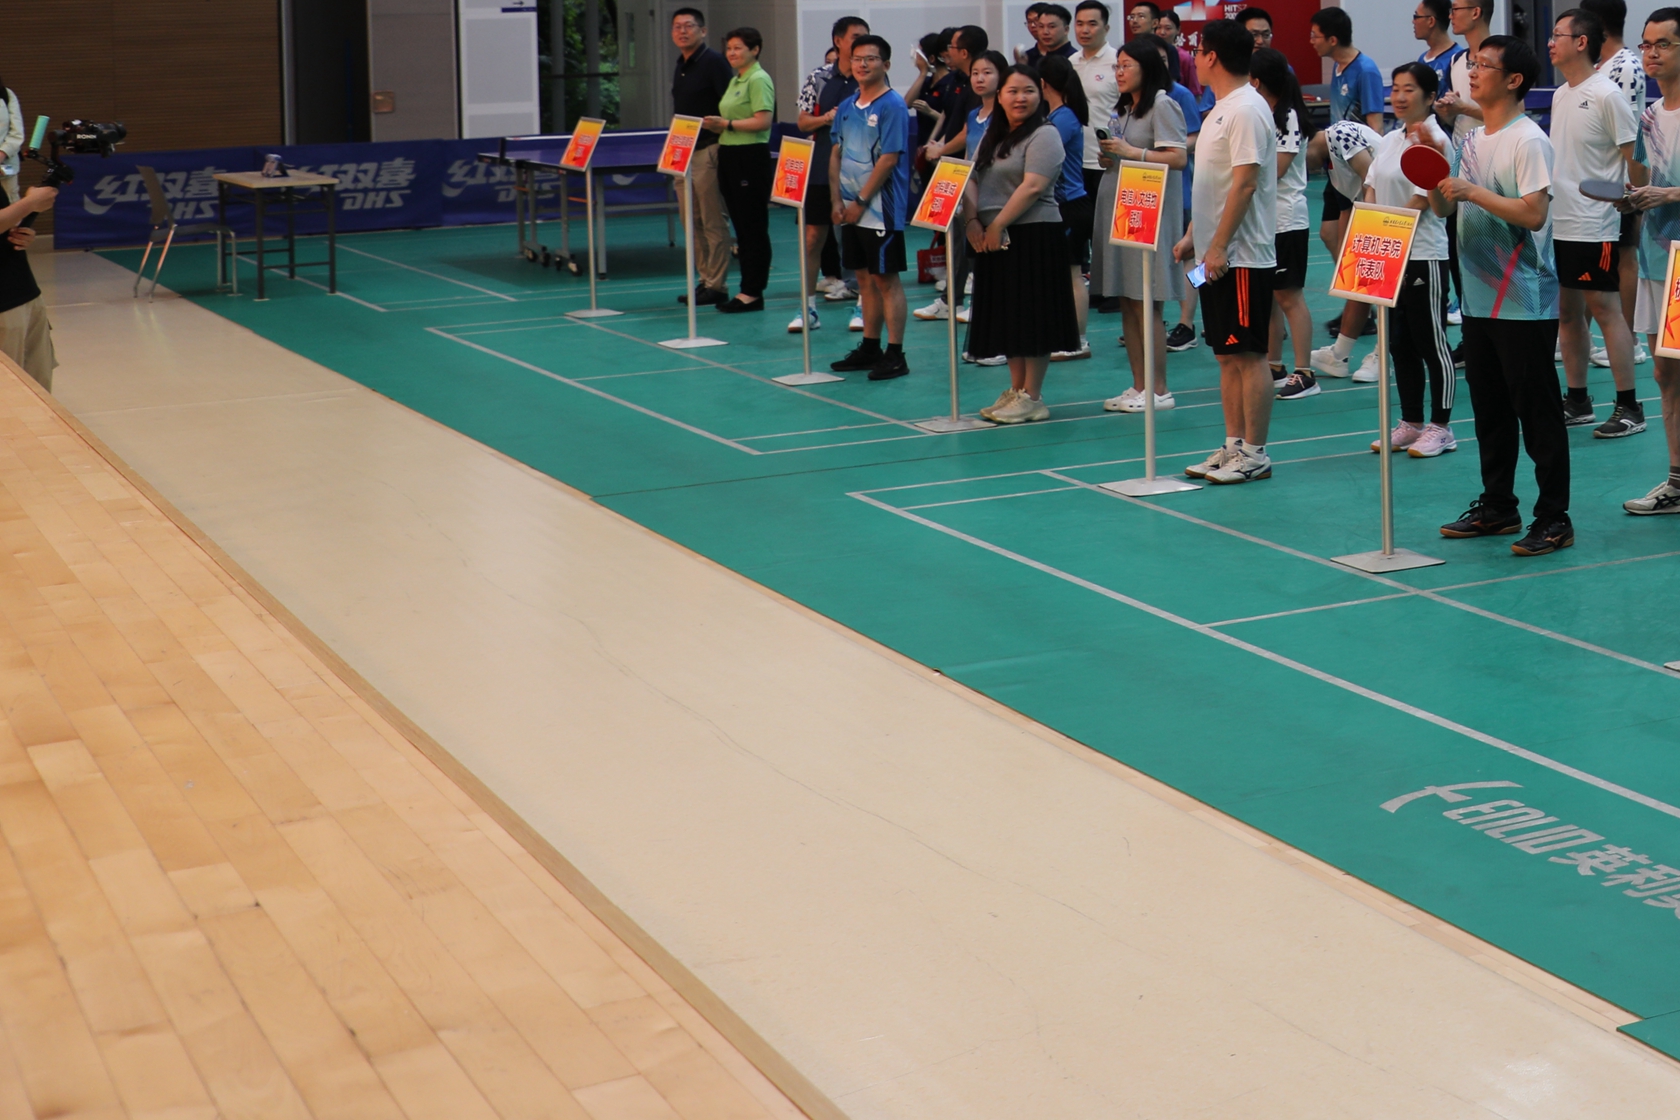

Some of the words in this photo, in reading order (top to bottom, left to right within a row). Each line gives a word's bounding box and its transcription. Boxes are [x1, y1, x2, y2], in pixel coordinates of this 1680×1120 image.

[340, 190, 411, 210] DHS
[1352, 233, 1403, 258] 计算机学院
[1355, 257, 1385, 280] 代表队
